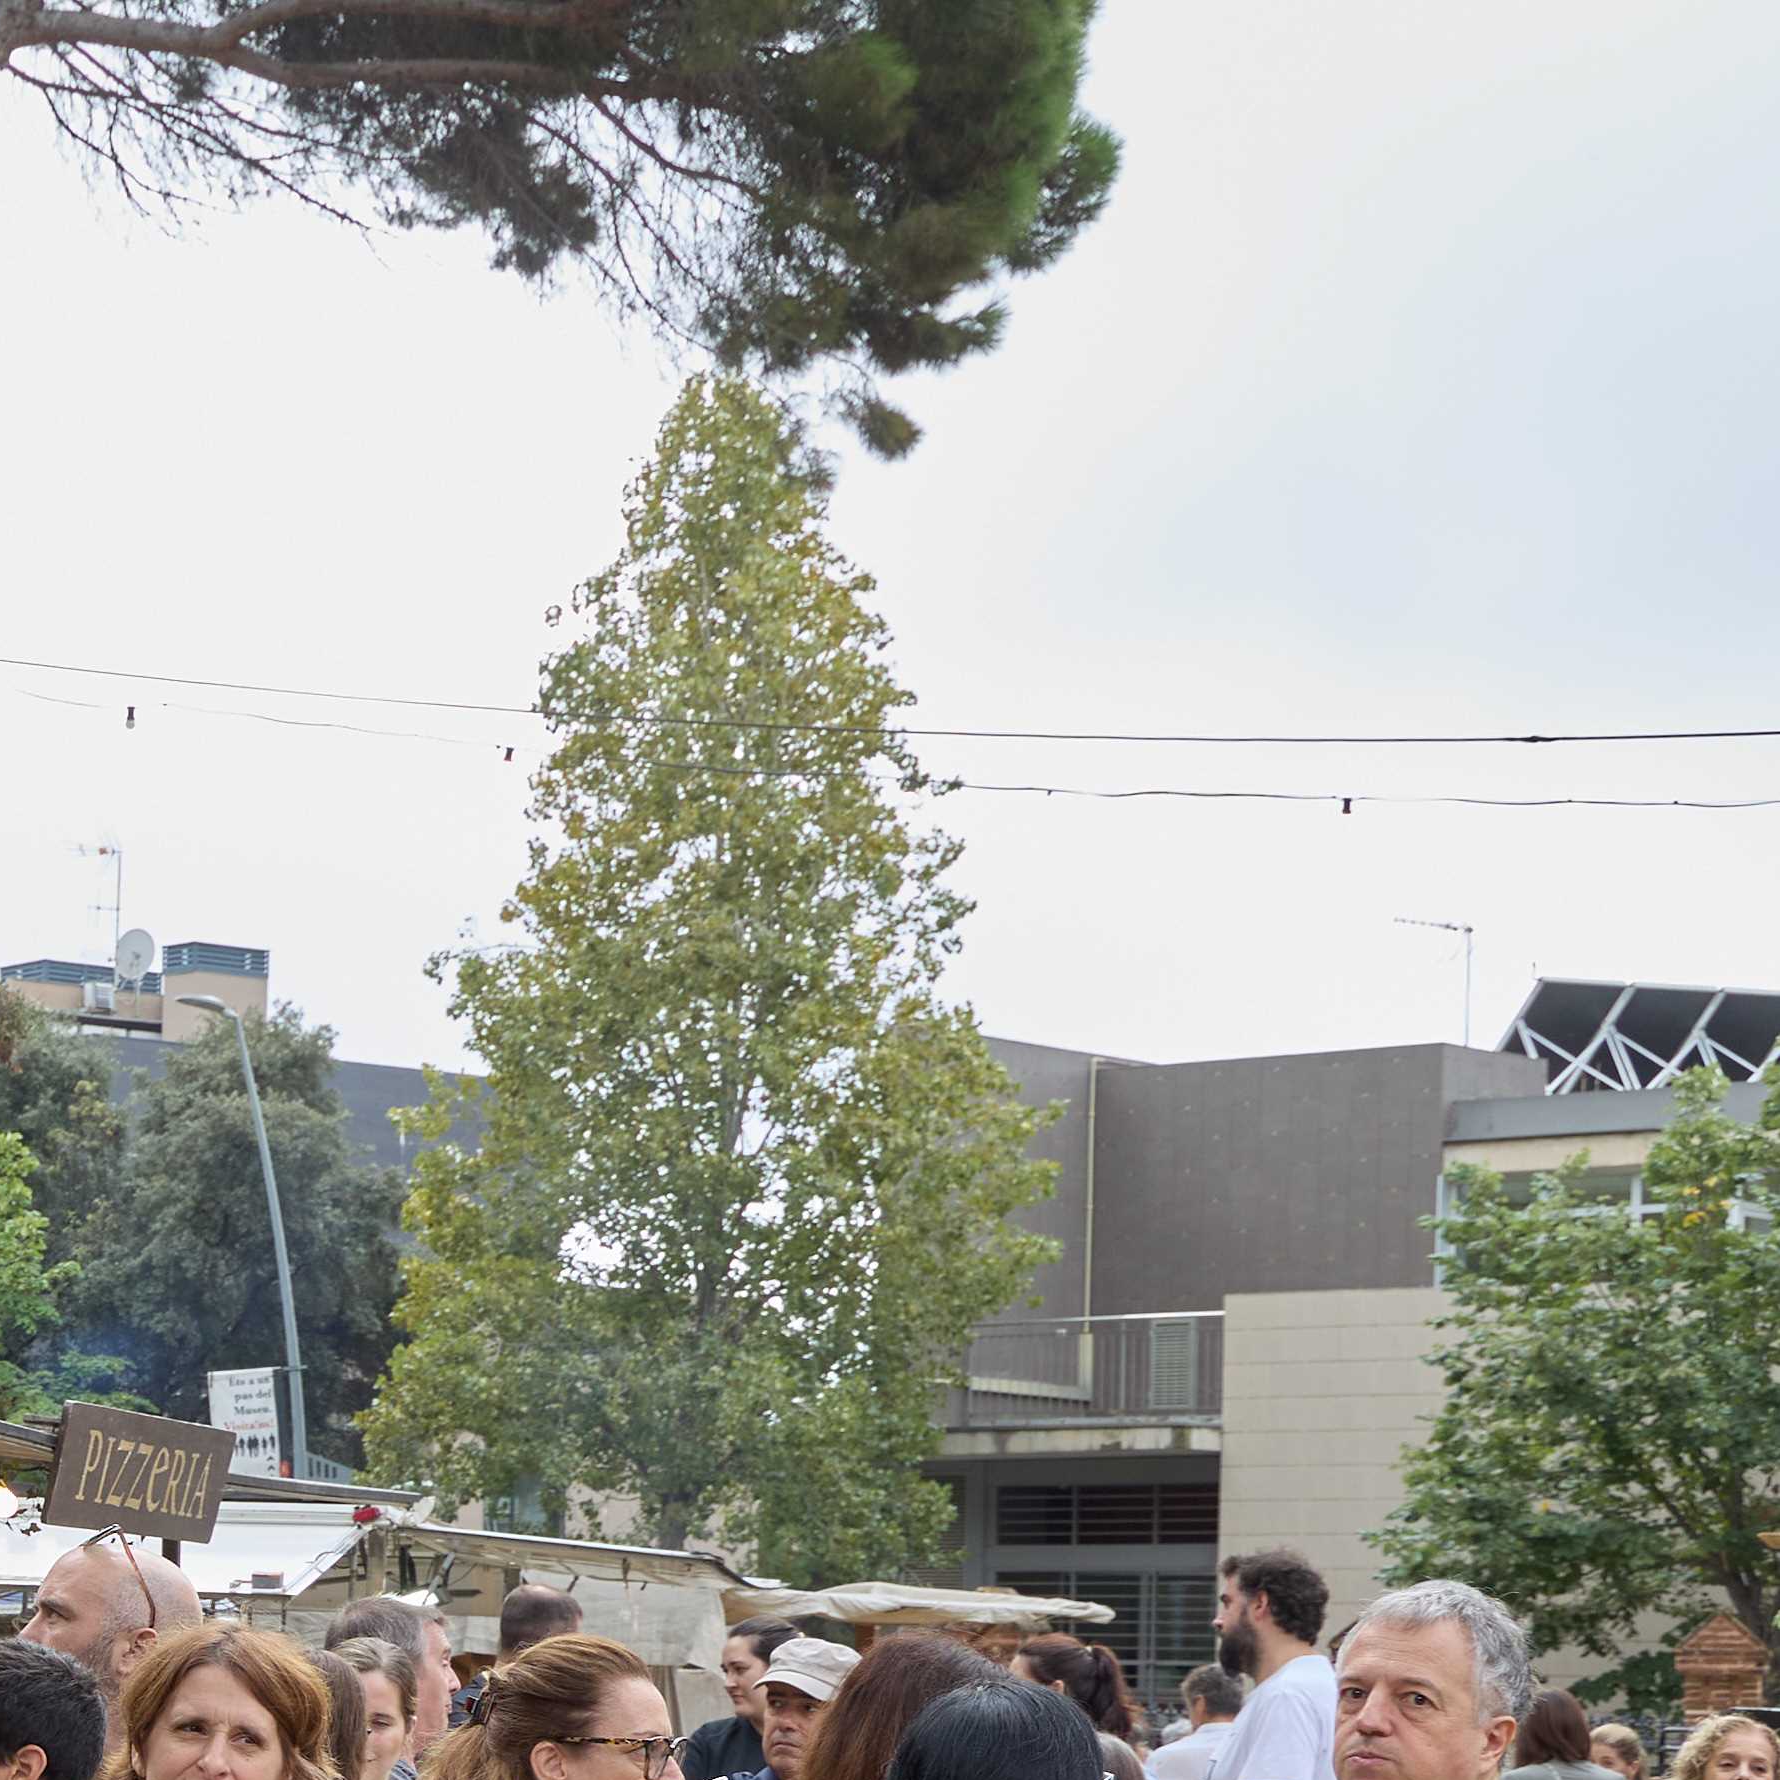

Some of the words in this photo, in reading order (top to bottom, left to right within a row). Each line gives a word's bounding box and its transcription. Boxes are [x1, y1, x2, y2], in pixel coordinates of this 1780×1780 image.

[248, 1378, 256, 1386] a
[257, 1376, 271, 1386] un
[234, 1392, 259, 1403] pas
[258, 1389, 272, 1400] del
